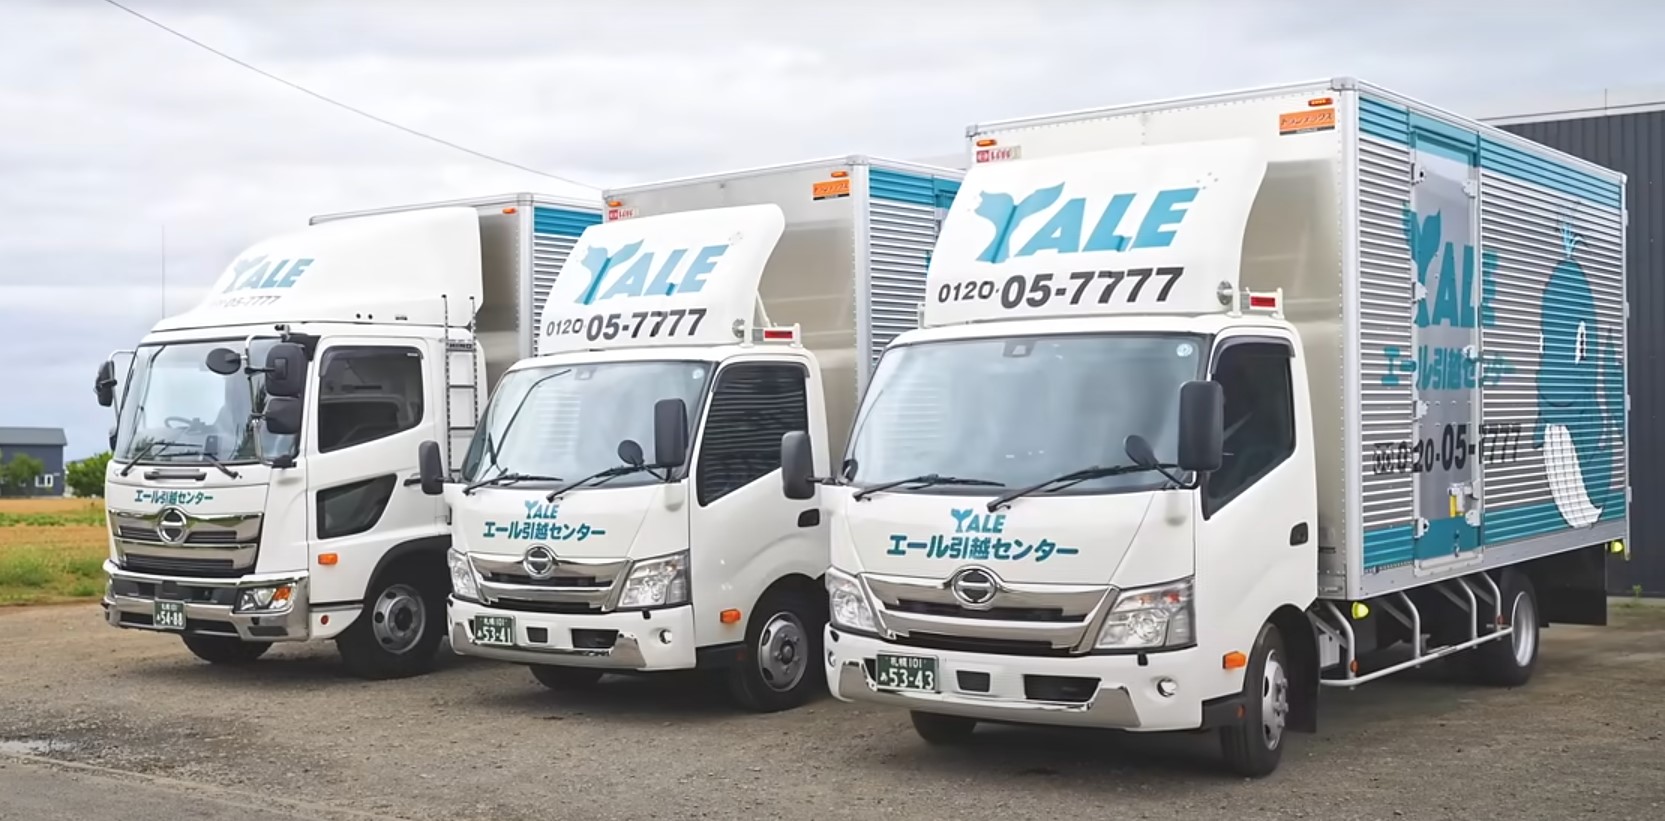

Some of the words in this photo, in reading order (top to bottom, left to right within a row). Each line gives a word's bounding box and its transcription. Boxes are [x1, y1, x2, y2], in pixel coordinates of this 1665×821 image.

[974, 182, 1200, 263] YALE
[222, 254, 315, 294] YALE
[574, 239, 730, 305] YALE
[1404, 202, 1498, 328] YALE
[134, 489, 214, 505] エール引越センター
[525, 500, 559, 519] YALE
[483, 521, 606, 541] エール引越センター
[951, 508, 1006, 533] YALE
[886, 534, 1079, 562] エール引越センター
[483, 626, 511, 643] 53-41
[889, 668, 934, 690] 53-43
